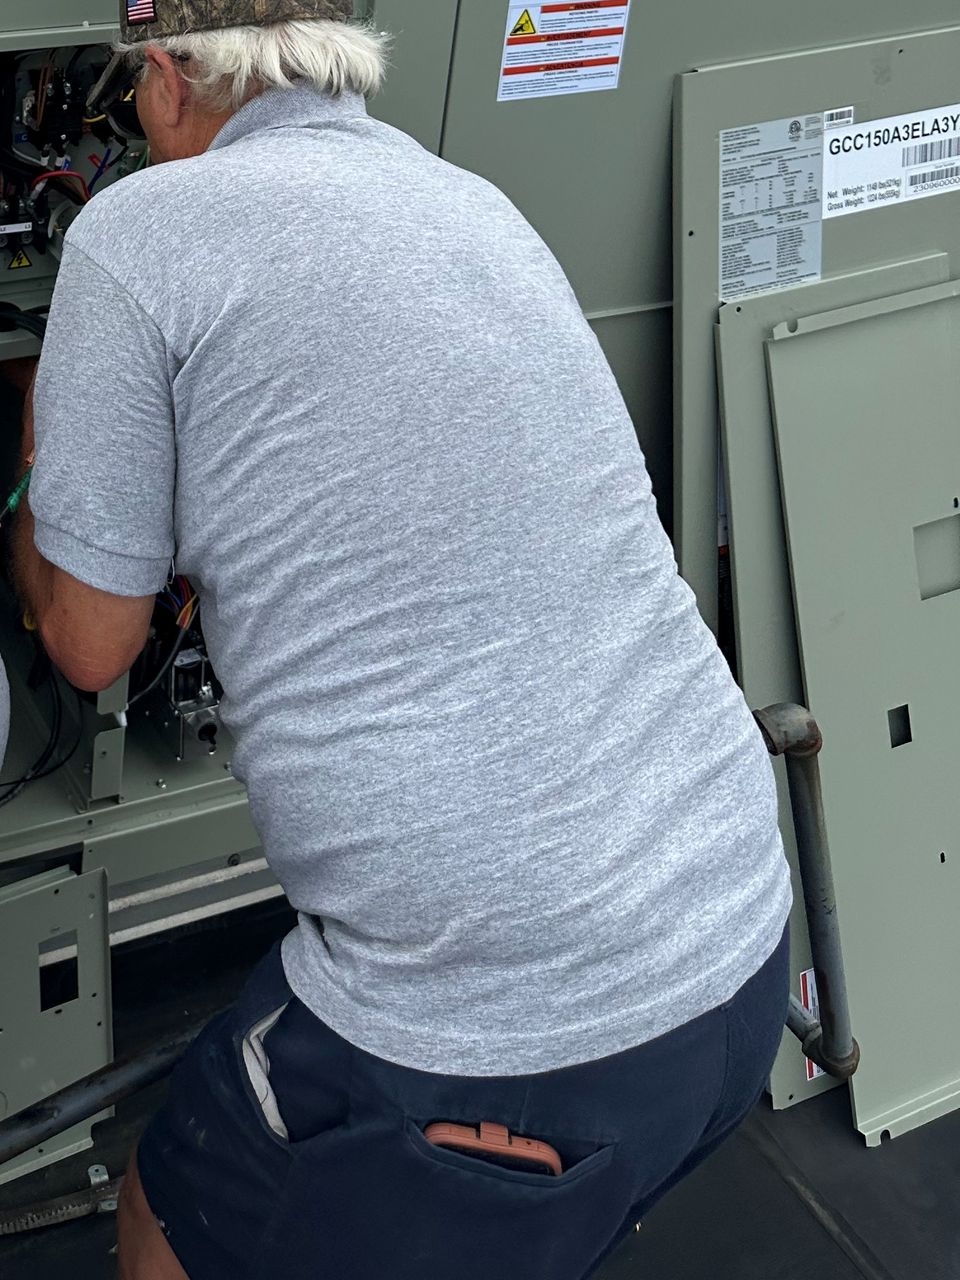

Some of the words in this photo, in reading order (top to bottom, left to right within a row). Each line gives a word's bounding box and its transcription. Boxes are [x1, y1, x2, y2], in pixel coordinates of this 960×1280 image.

[829, 114, 960, 155] GCC150A3ELA3Y
[827, 191, 838, 199] Net
[842, 185, 865, 197] Weight:
[827, 201, 843, 211] Gross
[845, 196, 865, 208] Weight:
